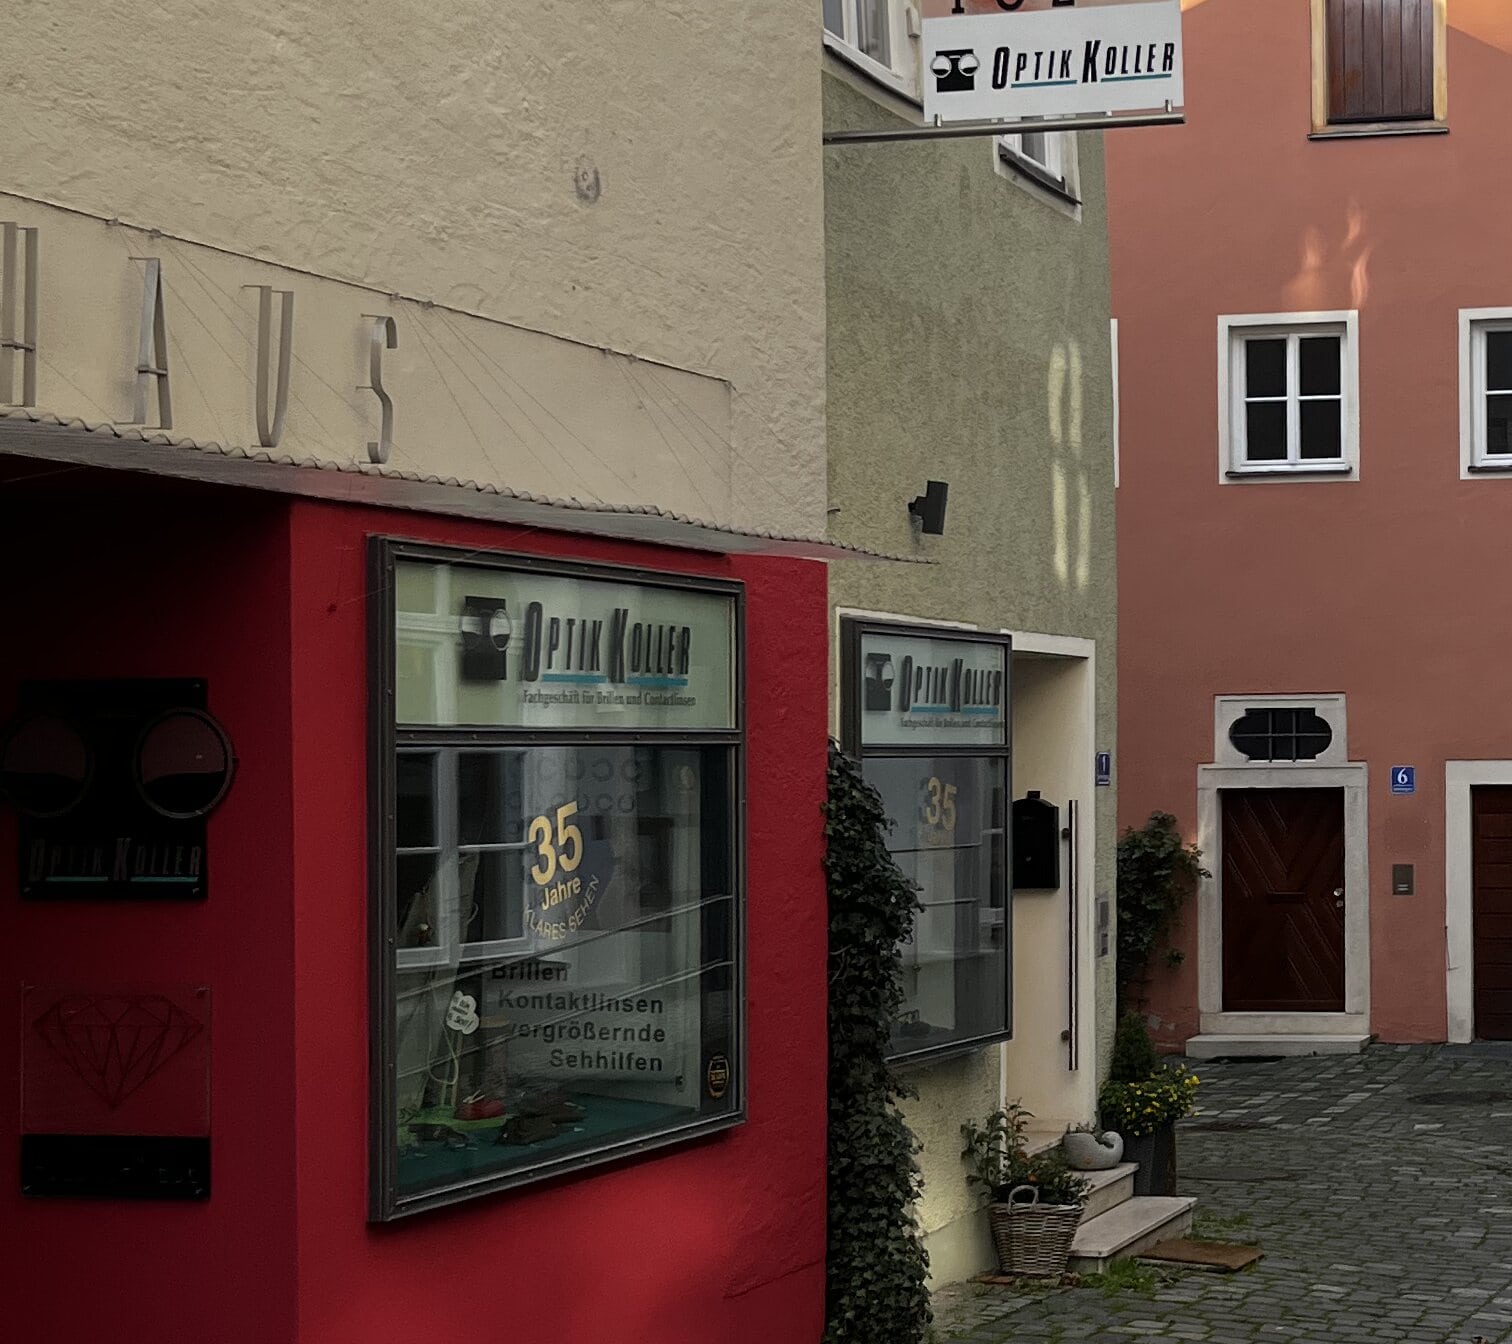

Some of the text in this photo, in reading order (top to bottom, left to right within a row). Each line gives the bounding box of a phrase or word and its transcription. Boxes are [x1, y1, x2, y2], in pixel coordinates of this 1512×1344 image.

[992, 39, 1175, 90] OPTIK KOLLER
[523, 601, 691, 684] OPTIK KOLLER
[626, 692, 643, 706] und
[1397, 767, 1408, 784] 6
[528, 800, 583, 886] 35
[541, 876, 582, 911] Jahre
[500, 988, 664, 1014] Kontaktlinsen
[550, 1048, 663, 1072] Sehhilfen
